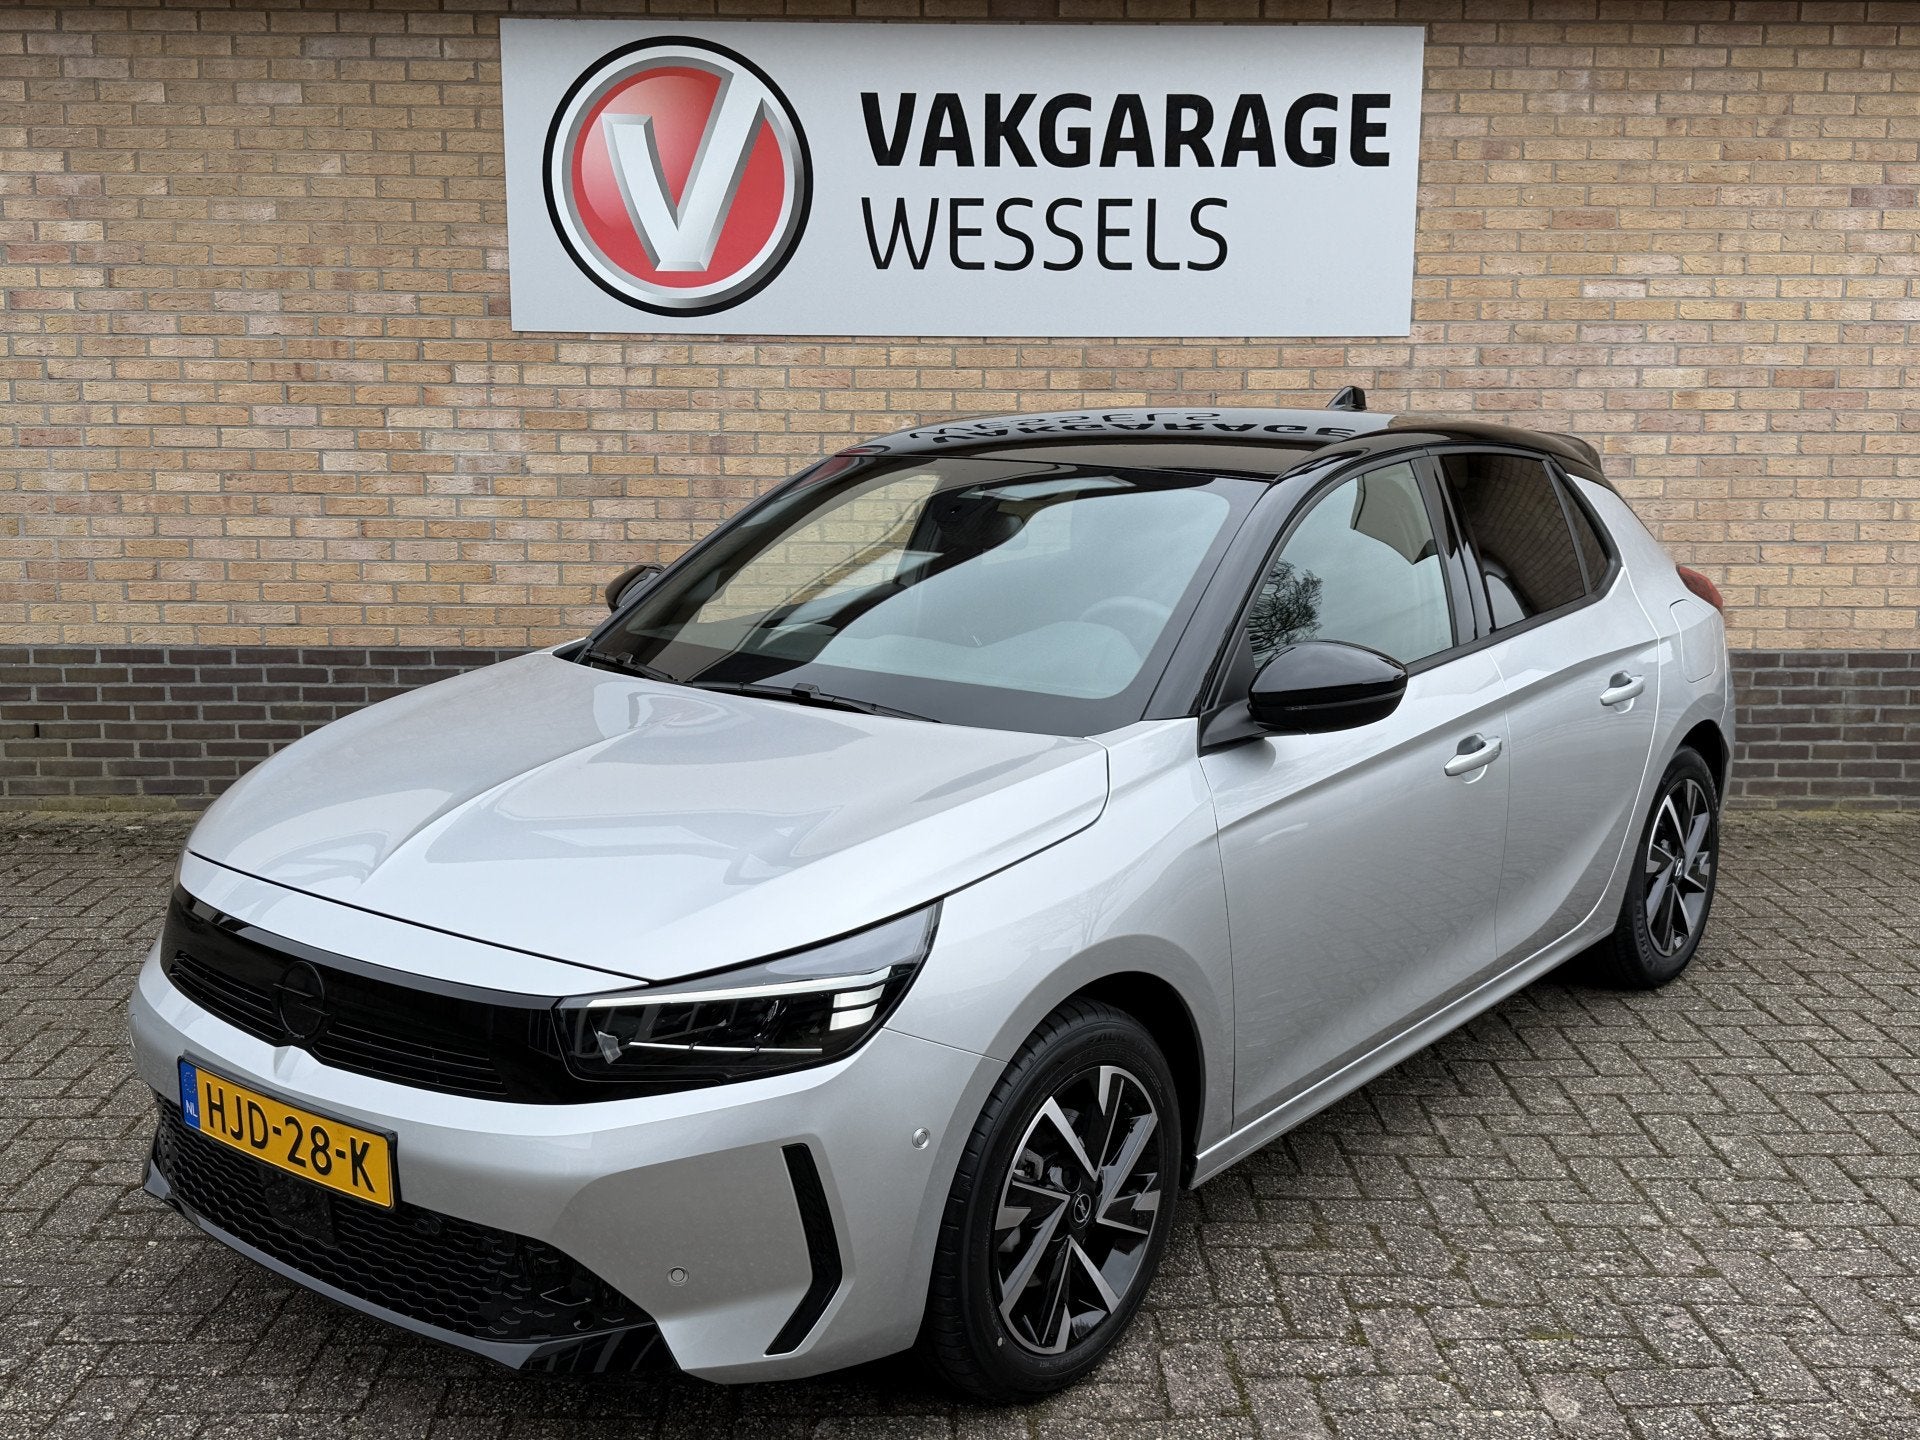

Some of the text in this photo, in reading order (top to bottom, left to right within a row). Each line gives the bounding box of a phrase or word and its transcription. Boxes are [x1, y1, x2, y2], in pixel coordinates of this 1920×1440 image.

[861, 92, 1391, 168] VAKGARAGE
[862, 197, 1228, 272] WESSELS
[185, 1100, 198, 1118] NL
[206, 1081, 377, 1194] HJD-28-K
